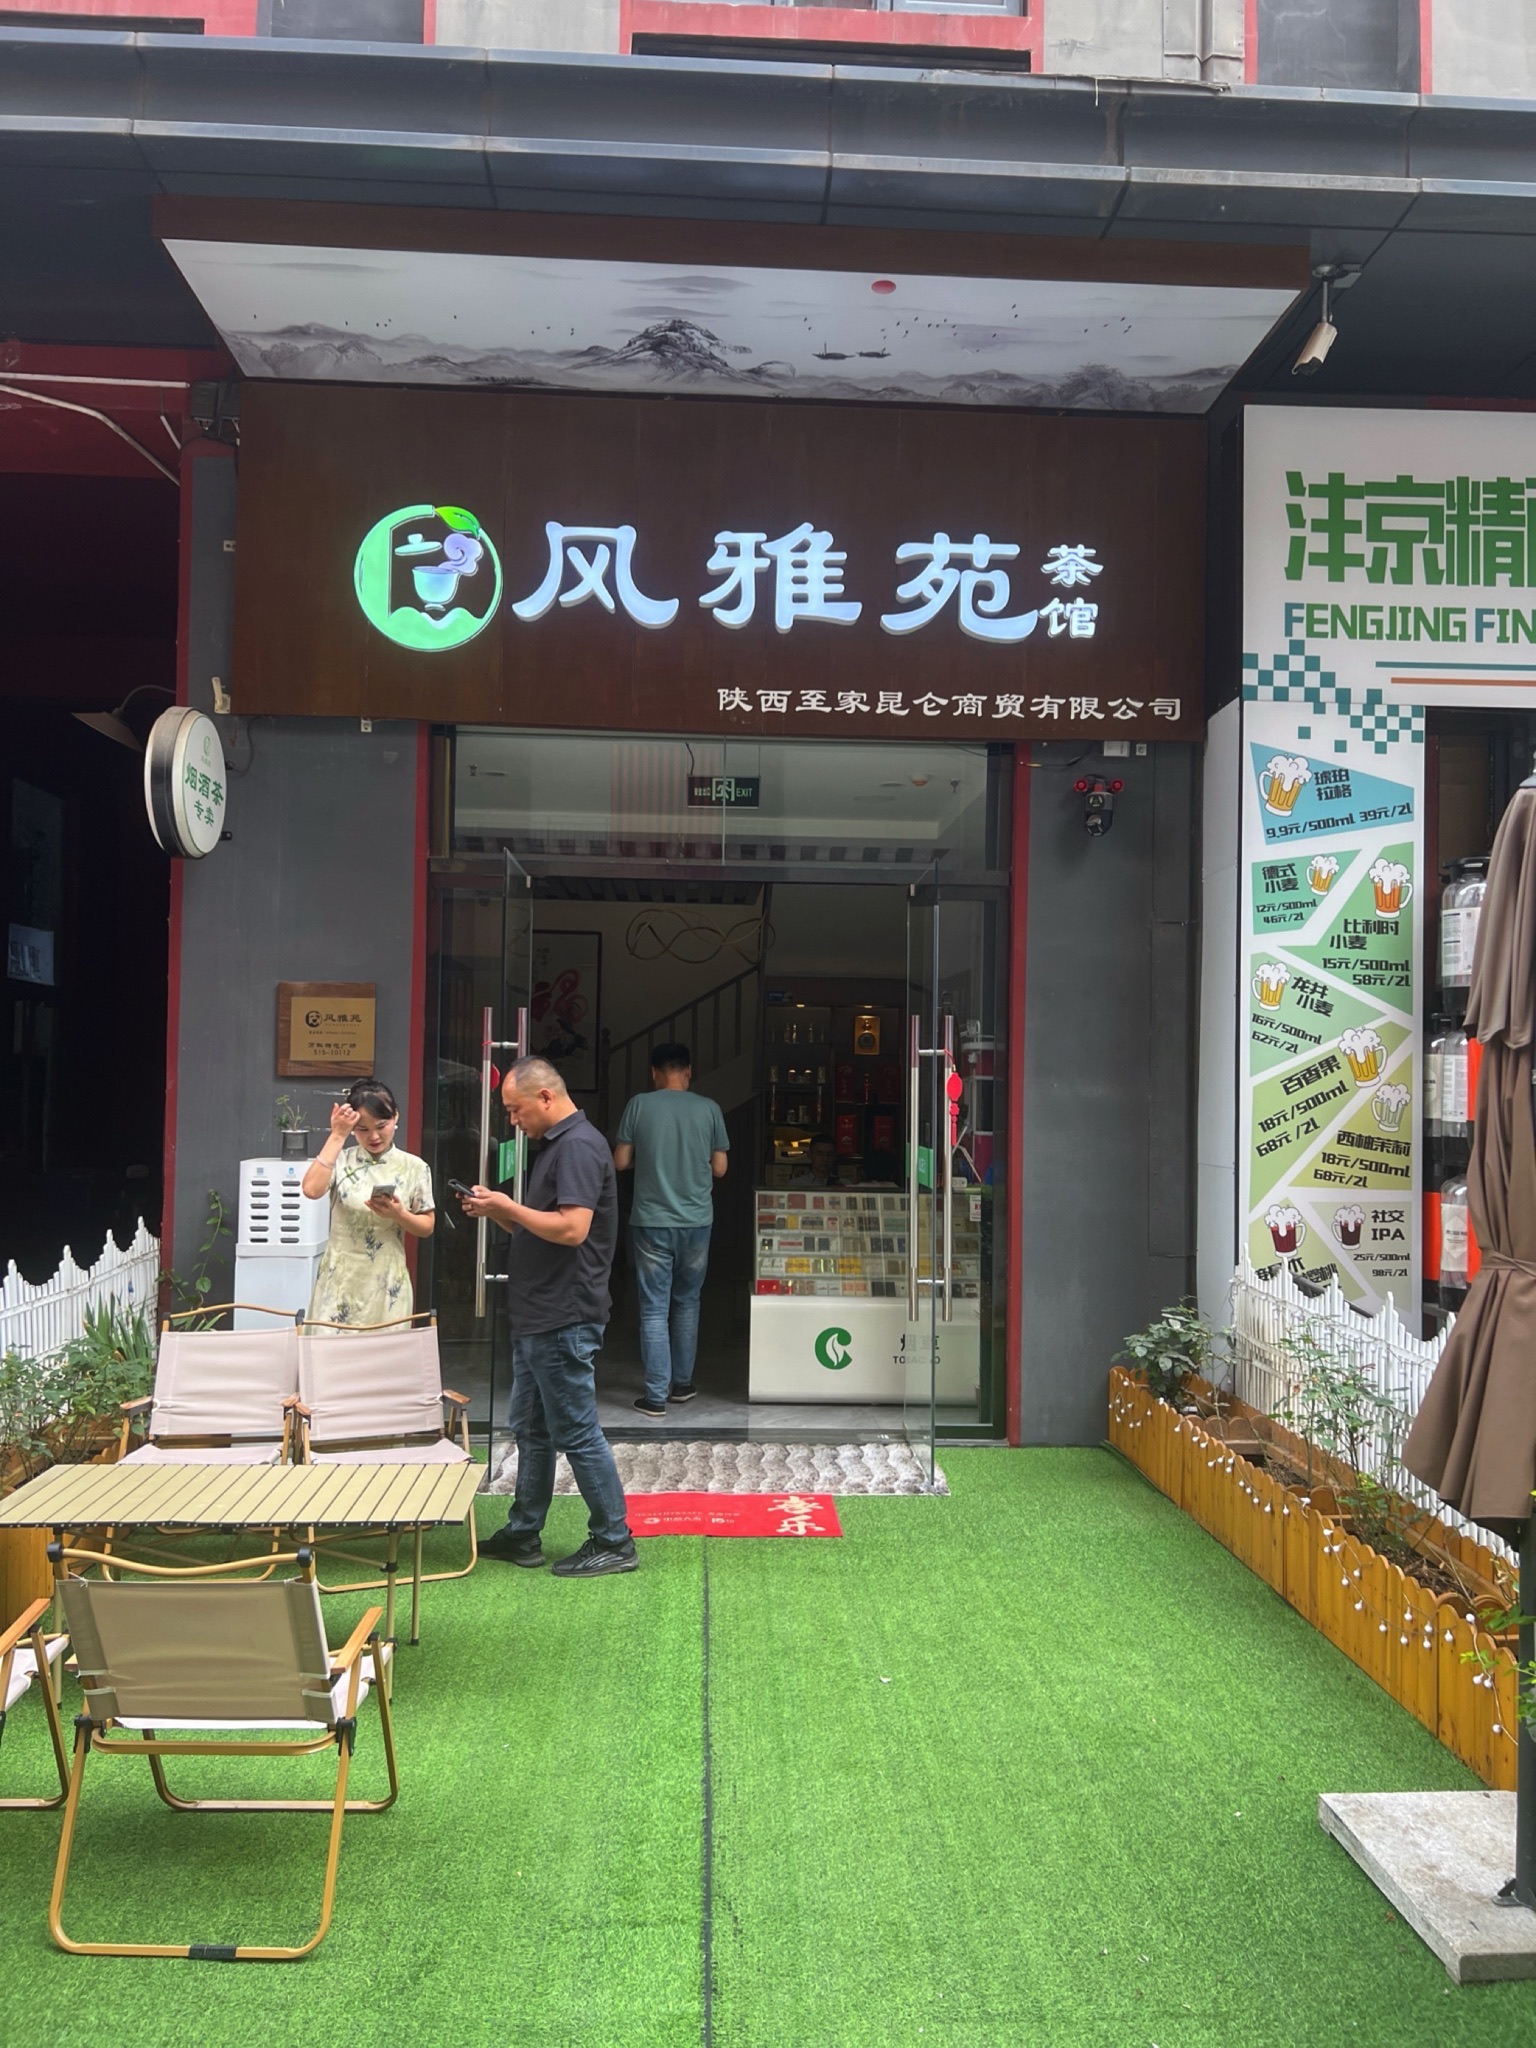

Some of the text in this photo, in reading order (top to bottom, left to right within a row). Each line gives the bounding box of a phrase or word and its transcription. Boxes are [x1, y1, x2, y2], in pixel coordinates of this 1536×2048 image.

[512, 521, 1038, 643] 风雅苑
[1040, 544, 1104, 638] 茶馆
[1284, 603, 1467, 642] FENGJING
[717, 687, 1181, 721] 陕西至家昆仑商贸有限公司
[185, 762, 224, 806] 烟酒茶
[1314, 768, 1350, 785] 琥珀
[736, 788, 753, 798] EXIT
[1316, 785, 1352, 801] 拉格
[194, 800, 215, 827] 专卖
[1262, 863, 1297, 880] 德式
[1264, 878, 1299, 894] 小麦
[1343, 919, 1399, 935] 比利时
[1330, 934, 1367, 950] 小麦
[1291, 976, 1329, 999] 龙井
[1296, 993, 1334, 1017] 小麦
[1280, 1054, 1342, 1096] 百香果
[1337, 1130, 1411, 1157] 西柚茉莉
[1371, 1209, 1404, 1223] 社交
[1371, 1228, 1405, 1241] IPA
